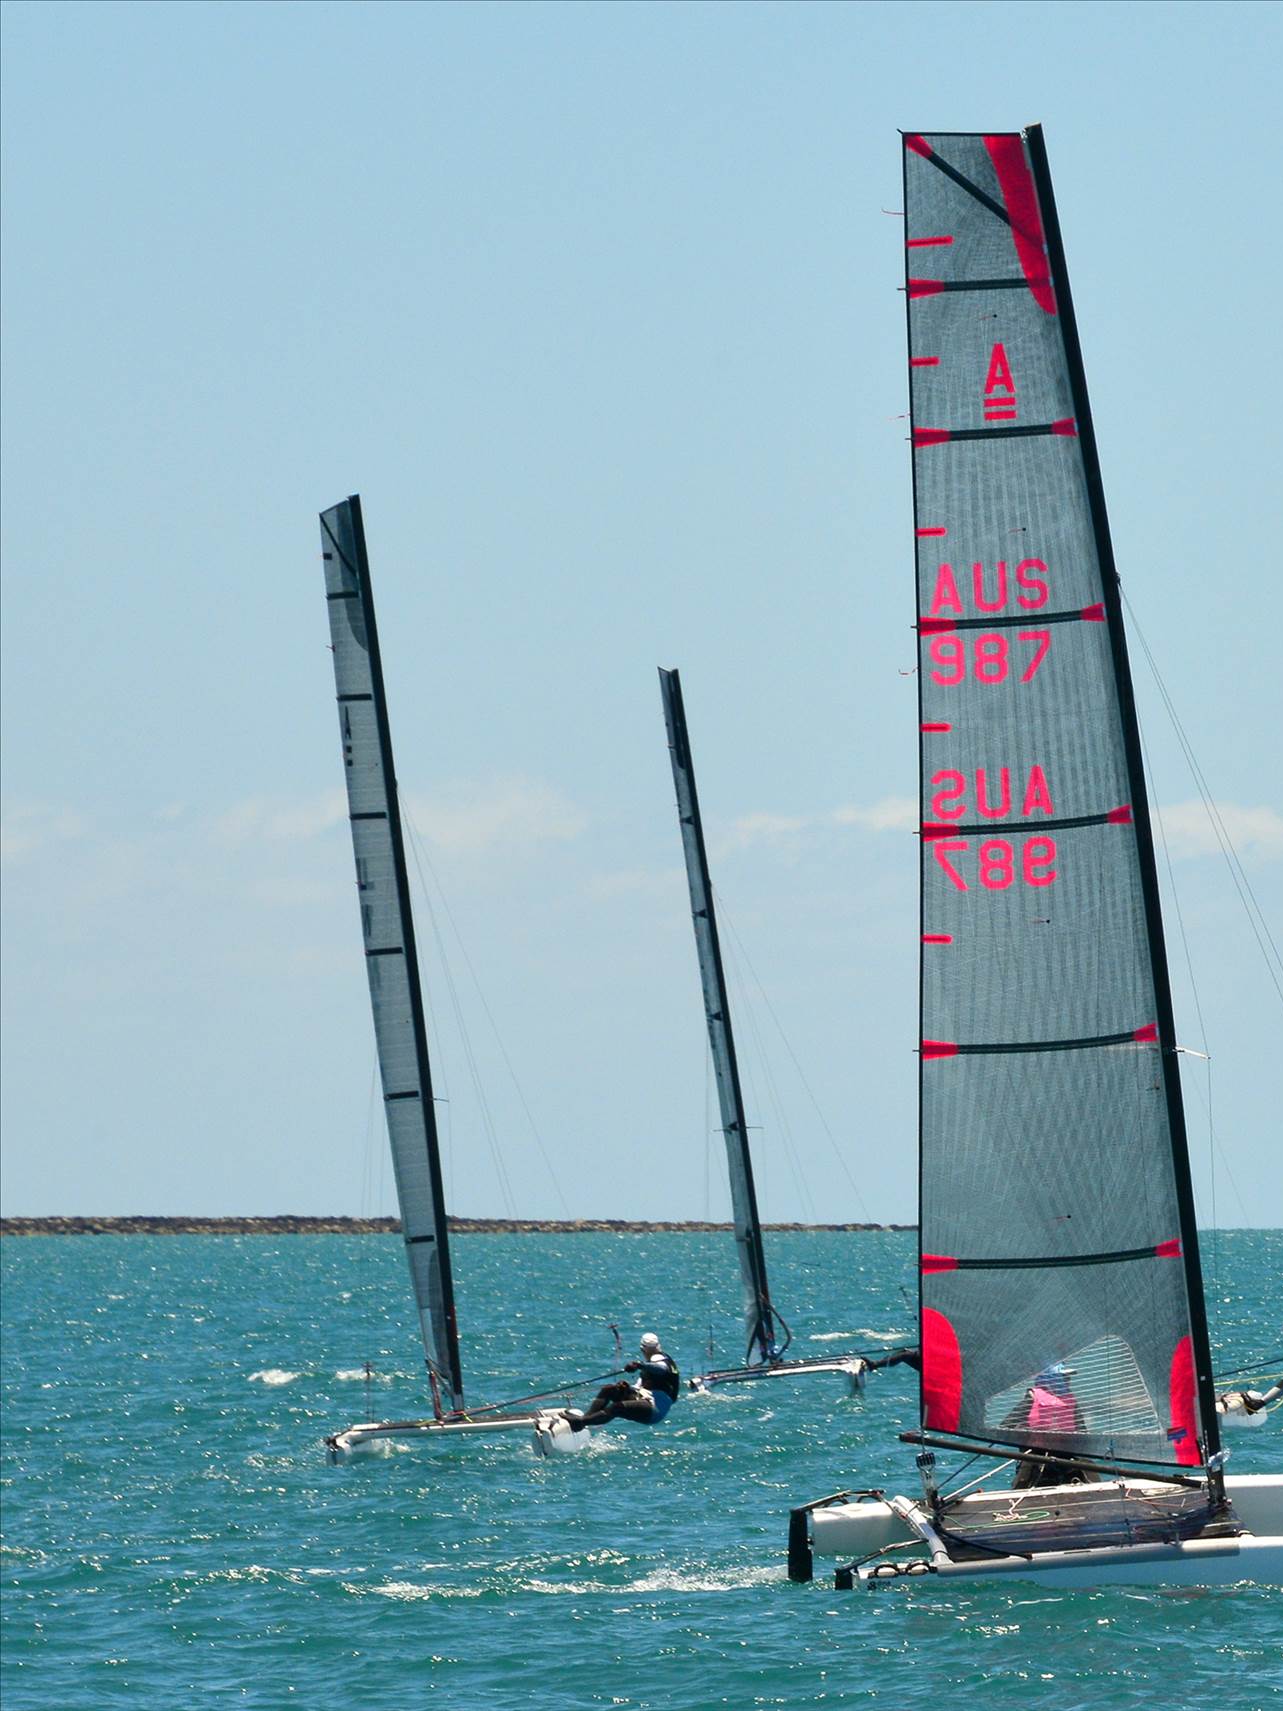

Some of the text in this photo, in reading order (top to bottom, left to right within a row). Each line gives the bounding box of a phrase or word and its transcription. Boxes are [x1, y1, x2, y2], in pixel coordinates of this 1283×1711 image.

[985, 342, 1016, 394] A
[929, 558, 1049, 615] AUS
[929, 630, 1051, 687] 987
